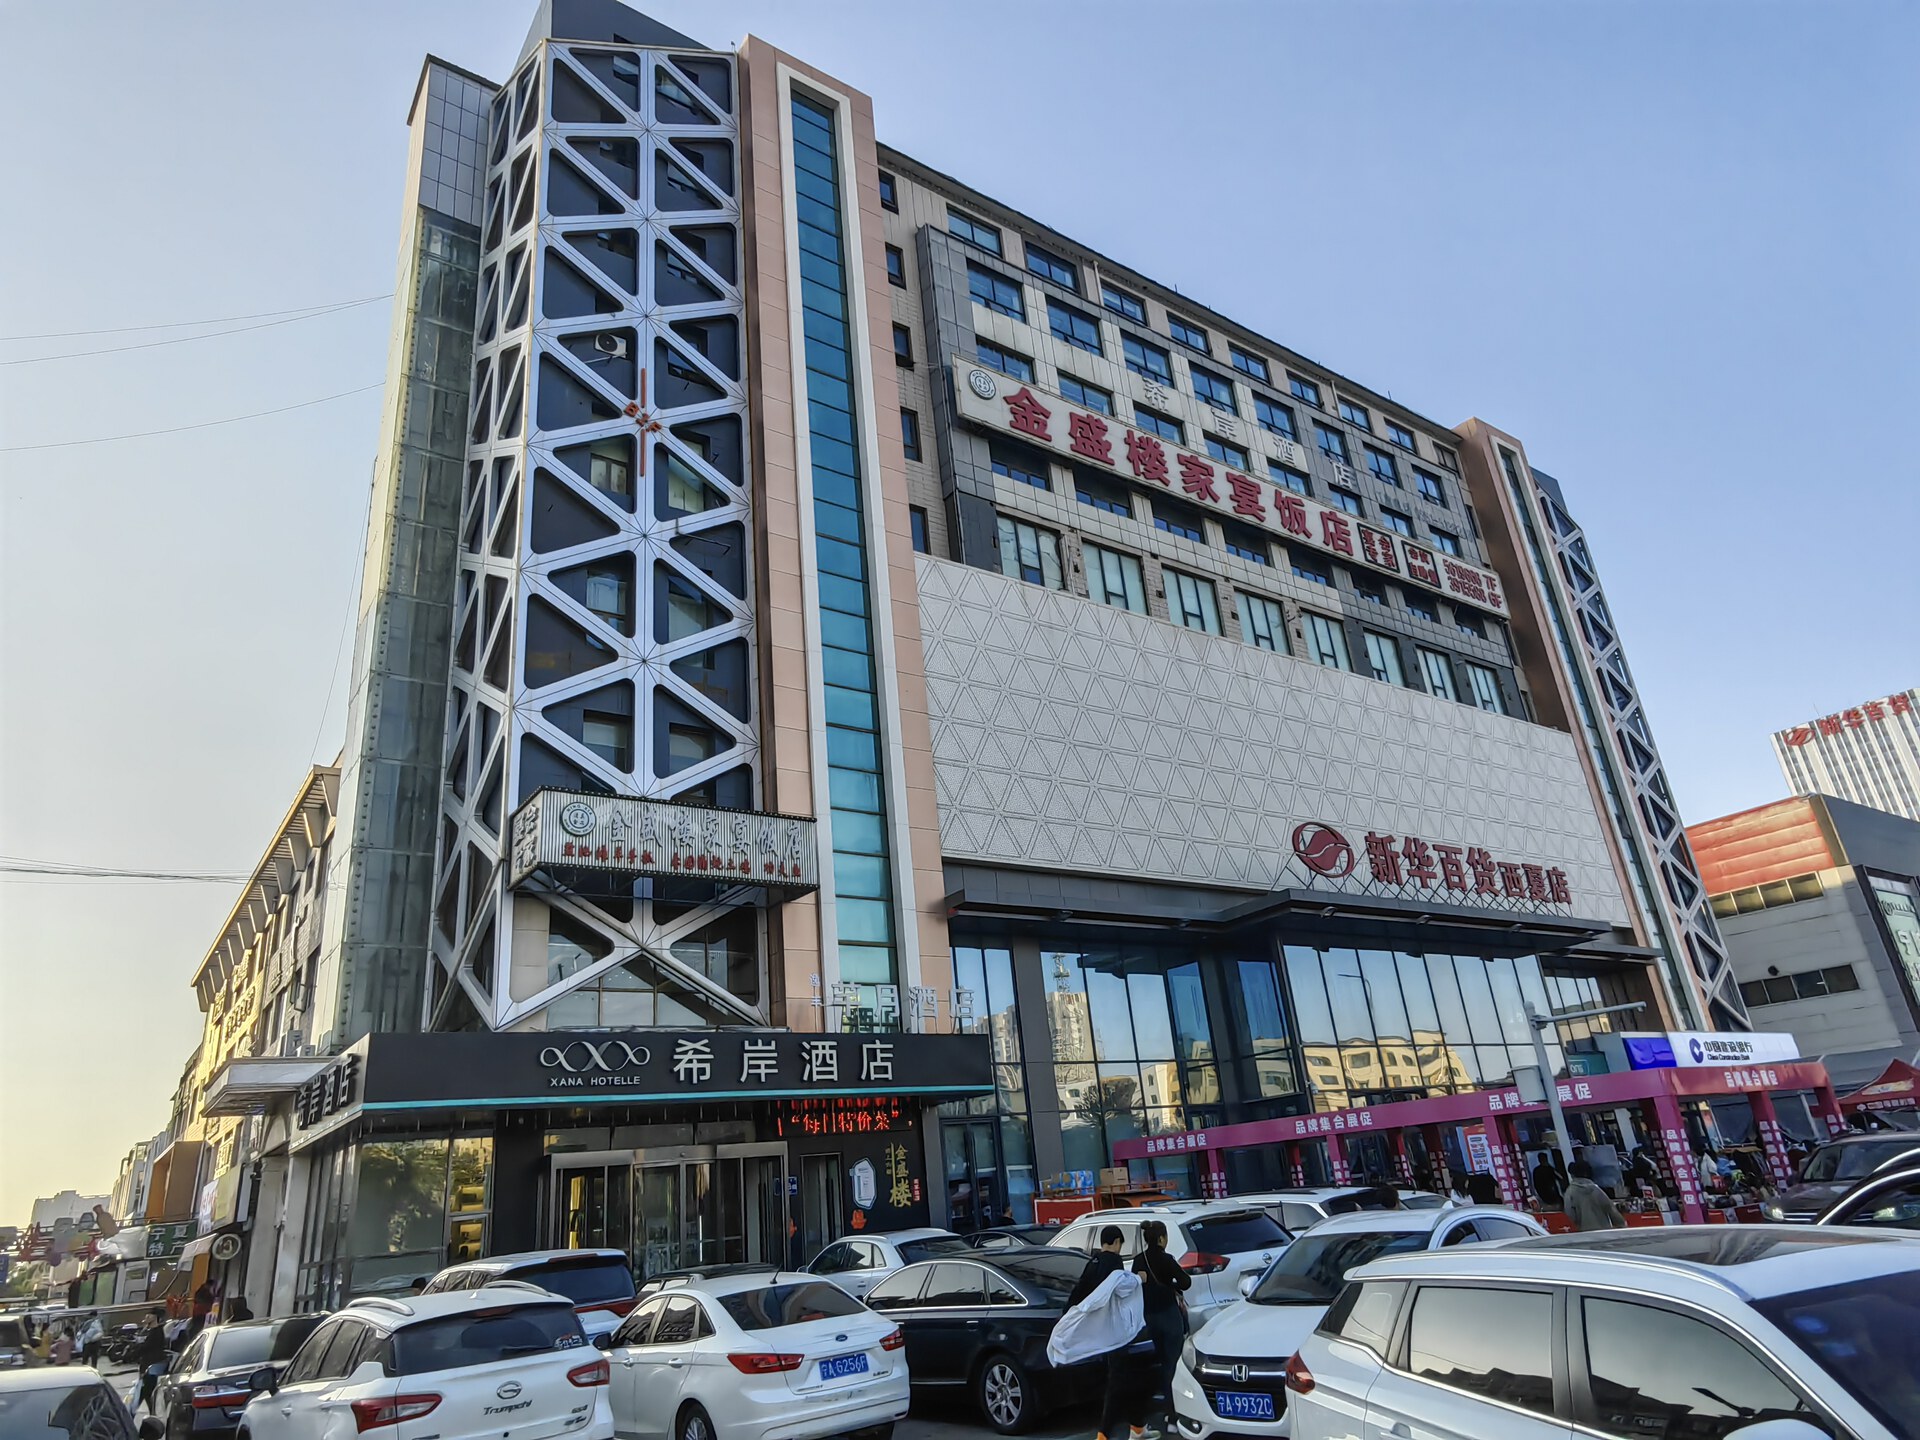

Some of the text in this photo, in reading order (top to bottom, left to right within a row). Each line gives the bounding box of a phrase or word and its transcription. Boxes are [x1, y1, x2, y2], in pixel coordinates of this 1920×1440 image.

[1143, 377, 1355, 490] 希岸酒店
[1003, 386, 1354, 556] 金盛楼家宴饭店
[1364, 831, 1572, 905] 新华百货西夏店
[1703, 1040, 1753, 1053] 中国建设银行
[672, 1038, 894, 1084] 希岸酒店
[550, 1076, 641, 1087] XANA HOTELLE
[1295, 1111, 1373, 1135] 品牌集合展促
[1146, 1133, 1207, 1153] 品牌集合展促
[149, 1224, 189, 1241] 宁夏
[148, 1241, 187, 1257] 特产
